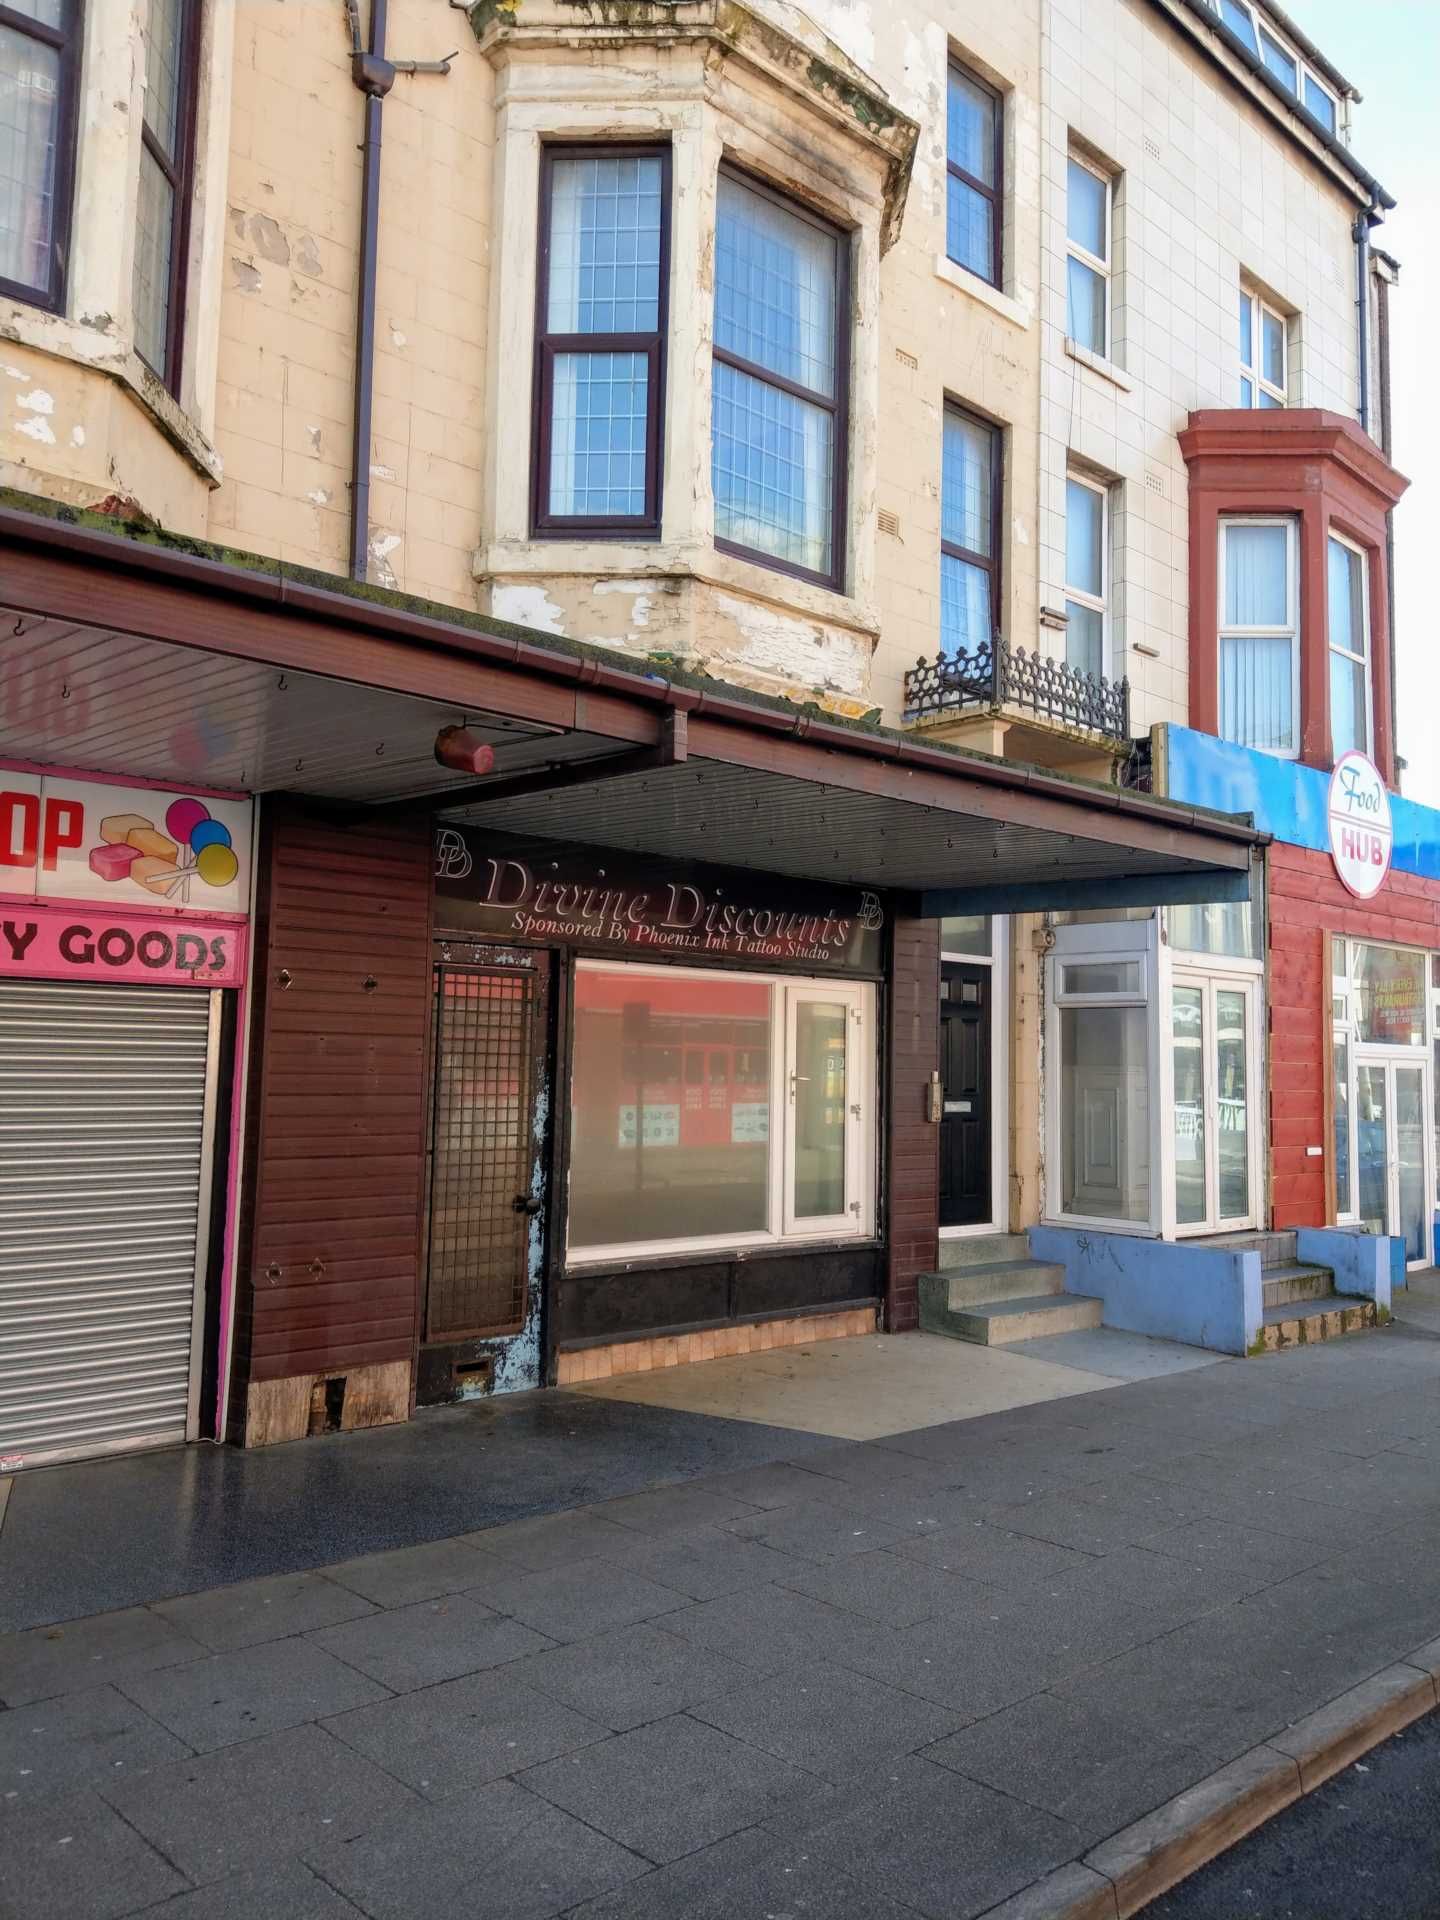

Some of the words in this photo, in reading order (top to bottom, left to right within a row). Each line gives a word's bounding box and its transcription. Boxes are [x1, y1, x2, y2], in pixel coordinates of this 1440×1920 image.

[1340, 766, 1381, 813] Food
[1341, 827, 1383, 866] HUB
[479, 858, 648, 923] Divine
[660, 883, 850, 946] Discounts
[0, 921, 38, 960] Y
[59, 925, 226, 971] GOODS
[511, 911, 602, 938] Sponsored
[608, 922, 631, 942] By
[635, 924, 700, 949] Phoenix
[705, 932, 728, 950] Ink
[735, 935, 781, 955] Tattoo
[785, 940, 829, 960] Studio
